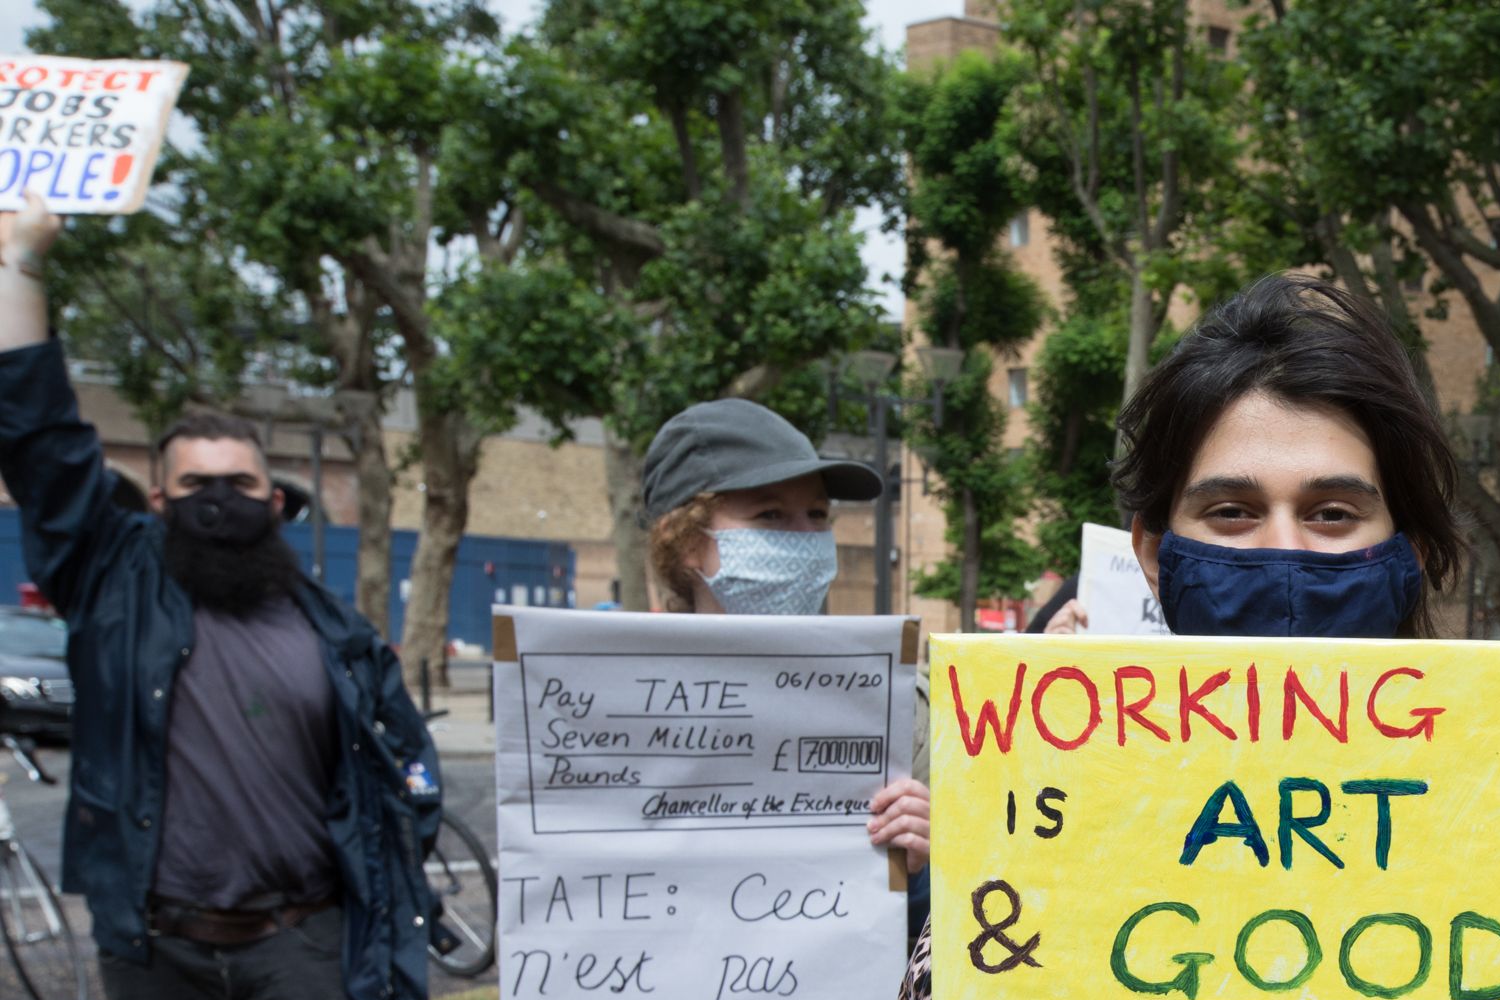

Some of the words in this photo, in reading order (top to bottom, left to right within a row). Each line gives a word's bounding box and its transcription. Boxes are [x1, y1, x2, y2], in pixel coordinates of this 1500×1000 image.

[0, 114, 137, 149] RKERS
[537, 677, 596, 721] Pay
[636, 679, 749, 712] TATE
[775, 671, 882, 691] 06/07/20
[948, 661, 1447, 757] WORKING
[541, 717, 632, 750] Seven
[646, 726, 755, 752] Million
[548, 757, 642, 787] Pounds
[773, 738, 792, 772] £
[642, 792, 739, 817] Chancellor
[741, 797, 758, 819] of
[1007, 787, 1067, 839] IS
[1179, 777, 1429, 871] ART
[503, 872, 679, 925] TATE:
[731, 873, 849, 922] Ceci
[968, 880, 1044, 975] &
[511, 949, 655, 997] n'est
